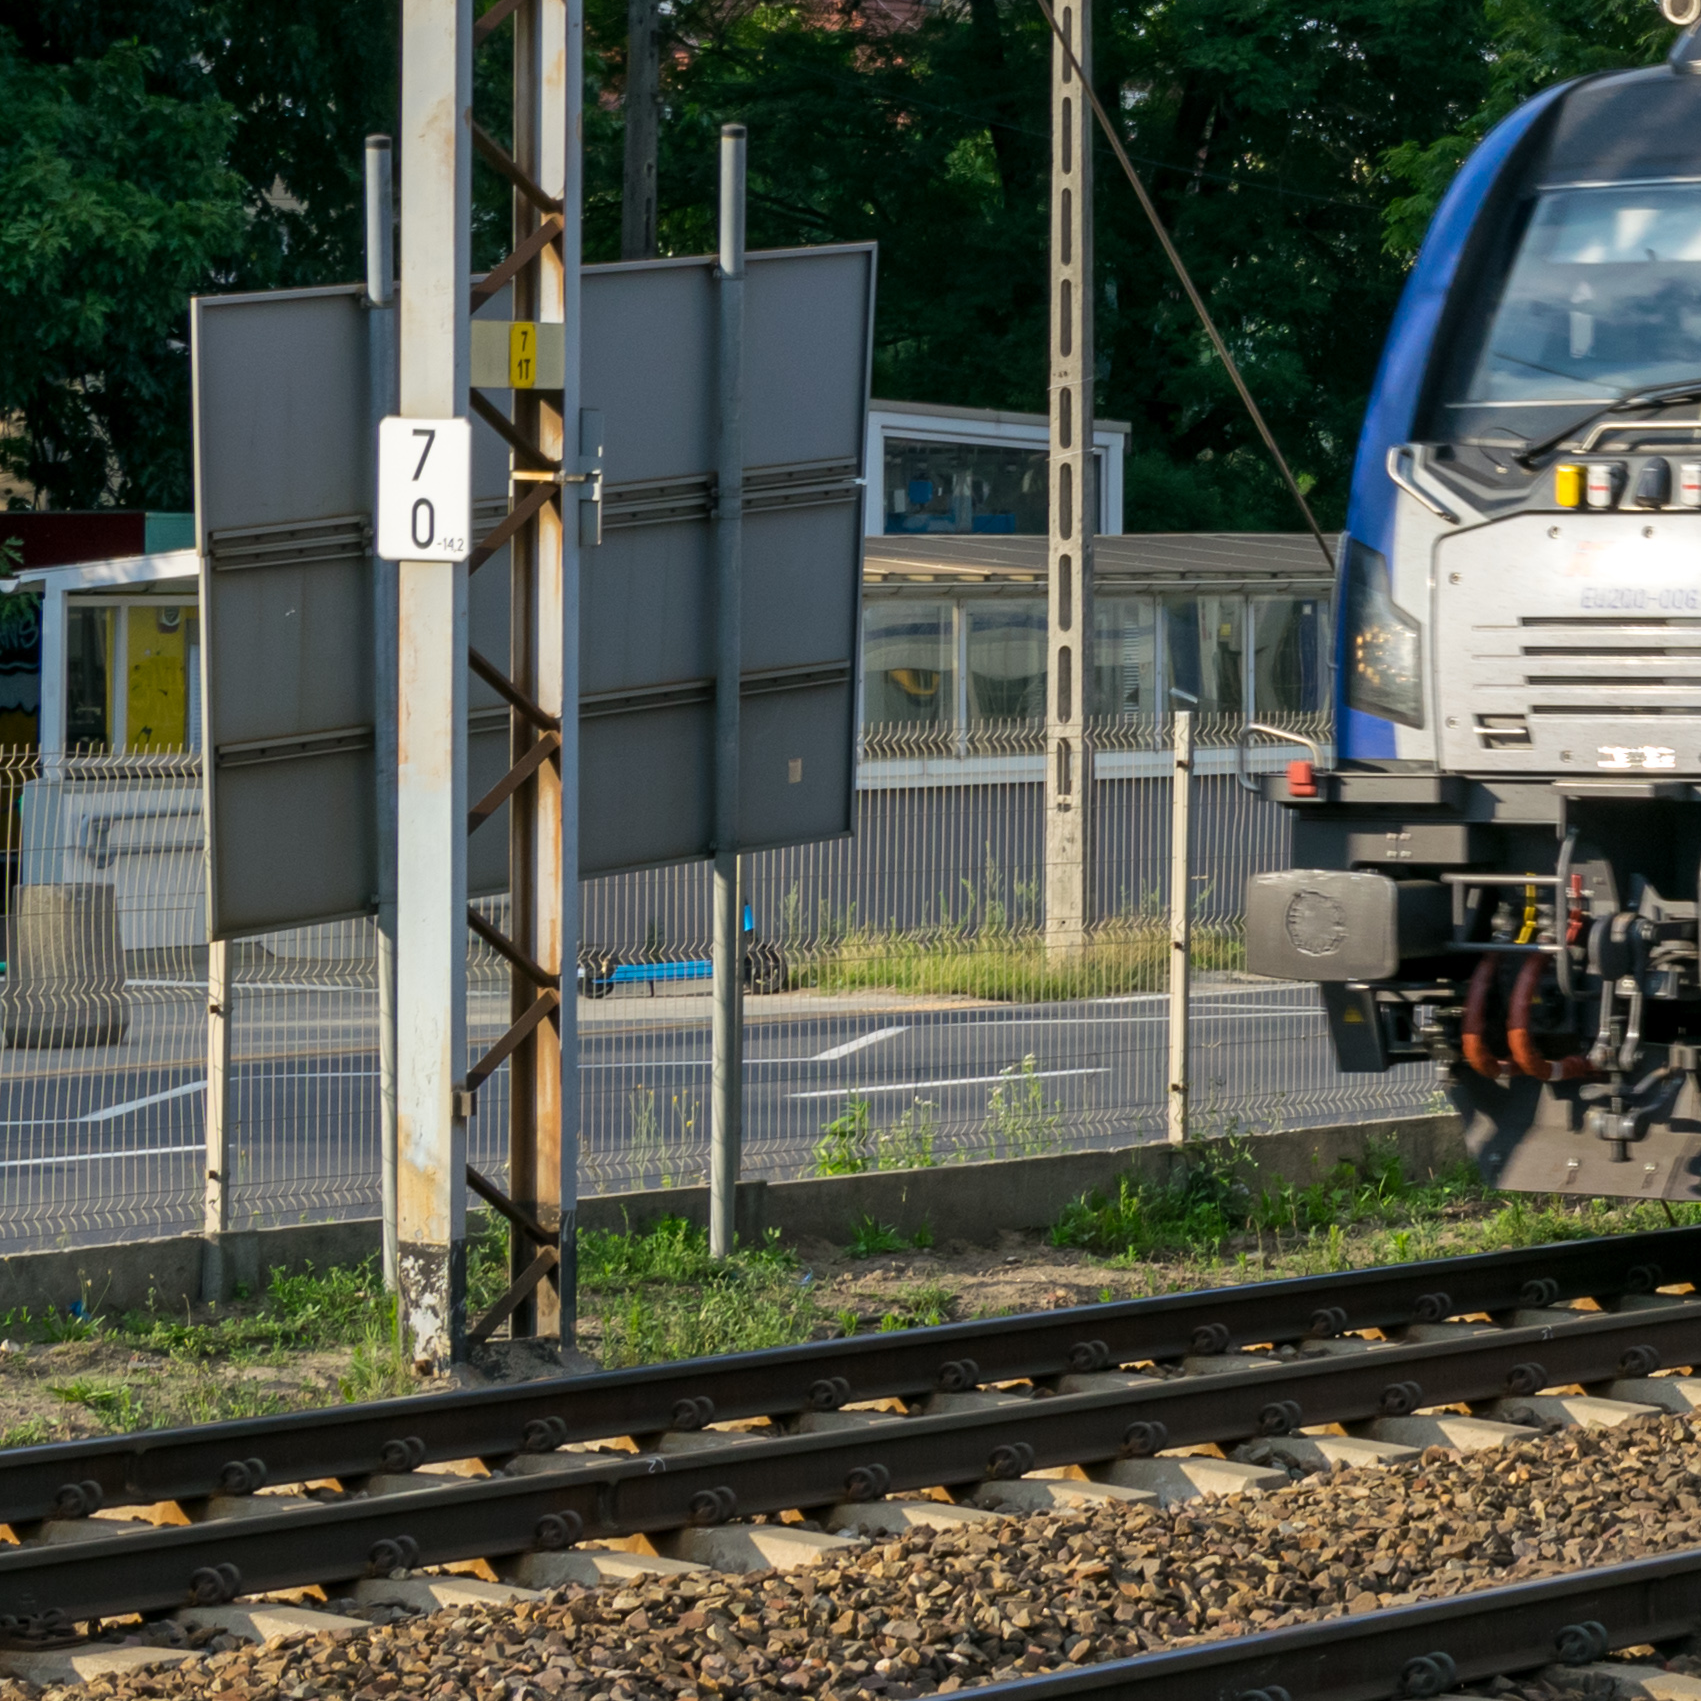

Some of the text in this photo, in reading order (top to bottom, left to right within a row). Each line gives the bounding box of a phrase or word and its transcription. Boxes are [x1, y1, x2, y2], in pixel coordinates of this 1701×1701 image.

[521, 331, 528, 352] 7
[517, 359, 531, 380] 1T
[412, 429, 436, 481] 7
[412, 498, 435, 550] 0
